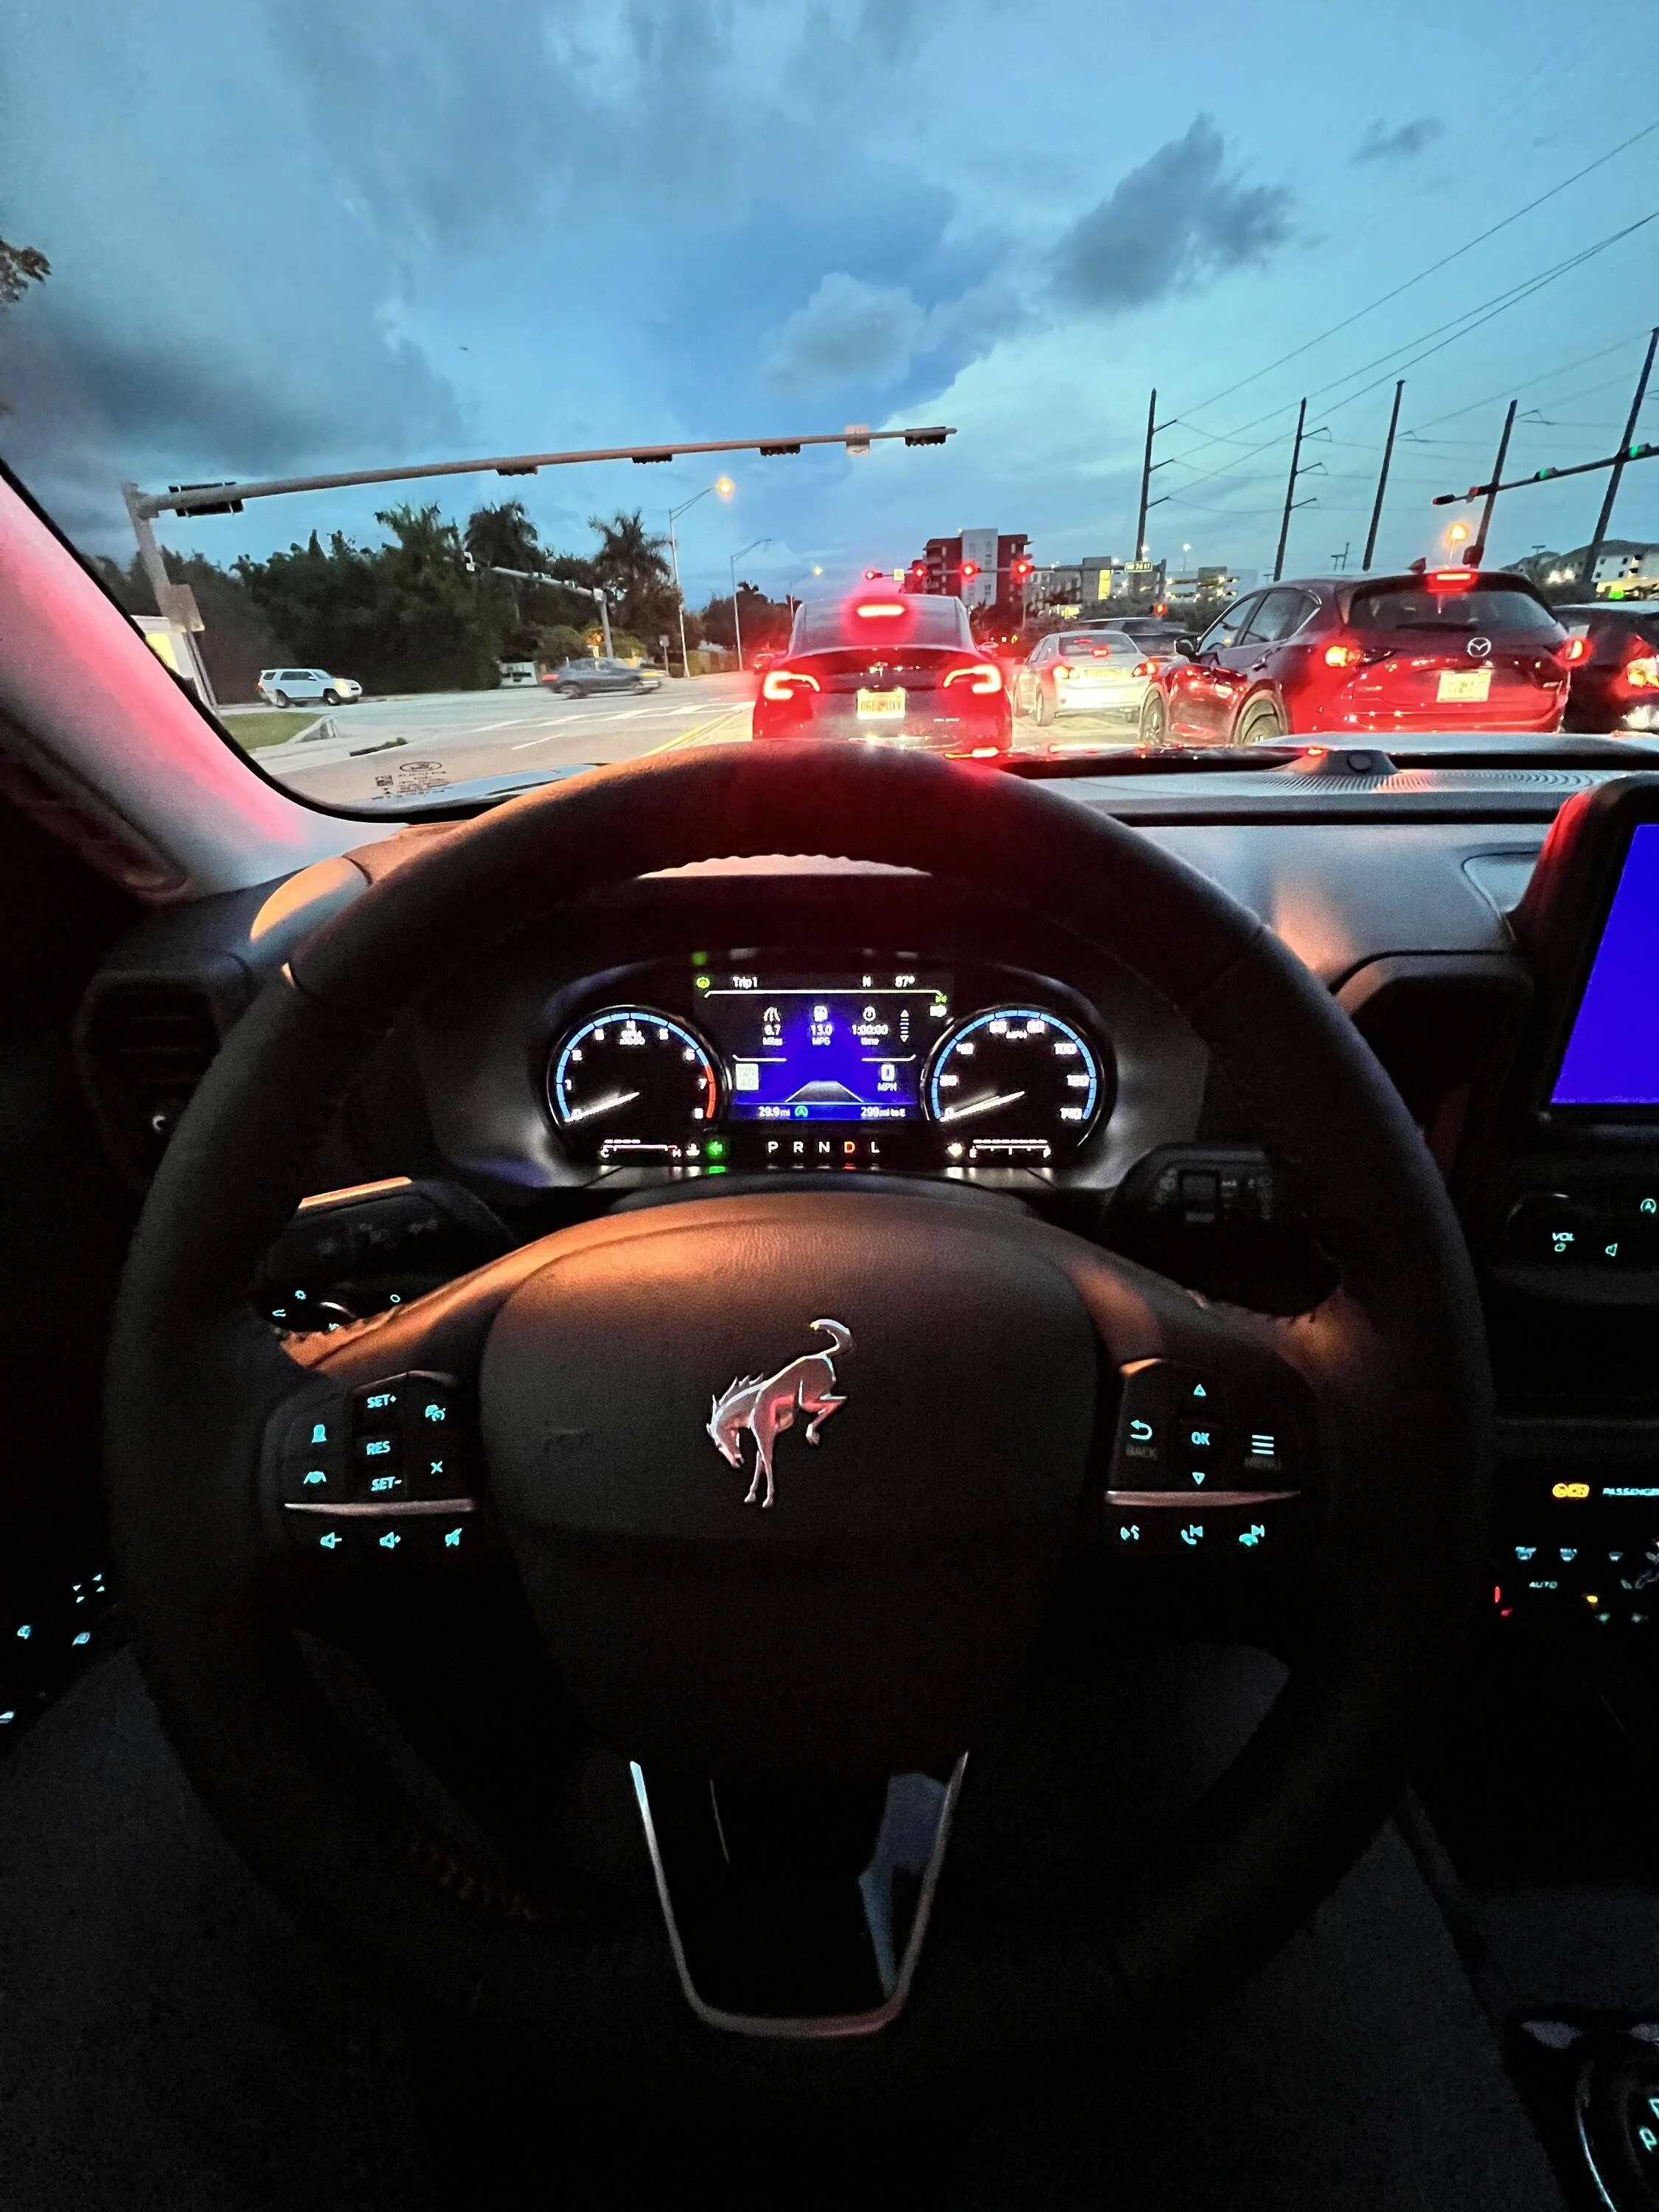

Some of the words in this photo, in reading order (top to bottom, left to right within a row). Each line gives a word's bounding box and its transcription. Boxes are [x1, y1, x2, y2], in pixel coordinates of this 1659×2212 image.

[862, 976, 872, 987] N
[810, 1024, 833, 1036] 13.0
[812, 1037, 831, 1046] MPG
[877, 1082, 897, 1092] MPH
[768, 1141, 779, 1153] P
[793, 1141, 804, 1153] R
[818, 1141, 830, 1153] N
[844, 1141, 855, 1153] D
[871, 1141, 880, 1153] L
[1552, 1232, 1575, 1242] VOL
[1191, 1431, 1210, 1446] OK
[366, 1440, 391, 1455] RES
[1529, 1581, 1558, 1589] AUTO
